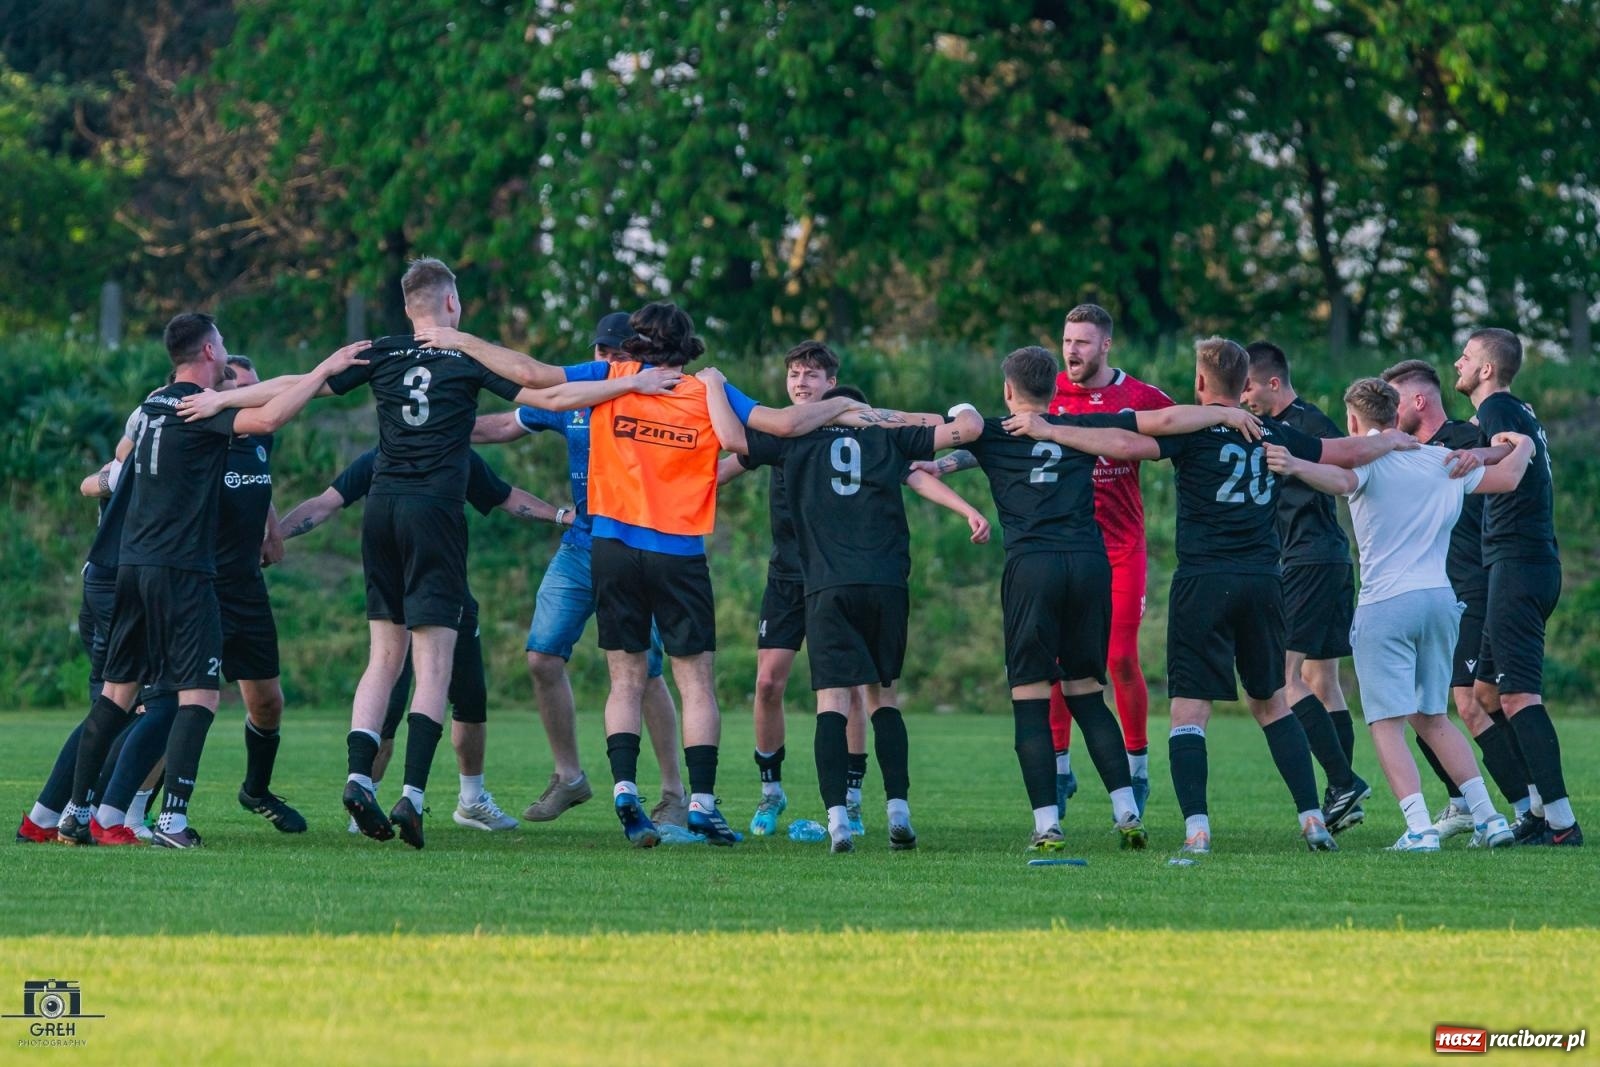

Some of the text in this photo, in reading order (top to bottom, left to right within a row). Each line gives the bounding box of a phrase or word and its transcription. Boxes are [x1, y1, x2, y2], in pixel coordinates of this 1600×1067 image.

[402, 366, 432, 426] 3
[830, 436, 862, 496] 9
[1029, 441, 1063, 484] 2
[1216, 443, 1276, 505] 20
